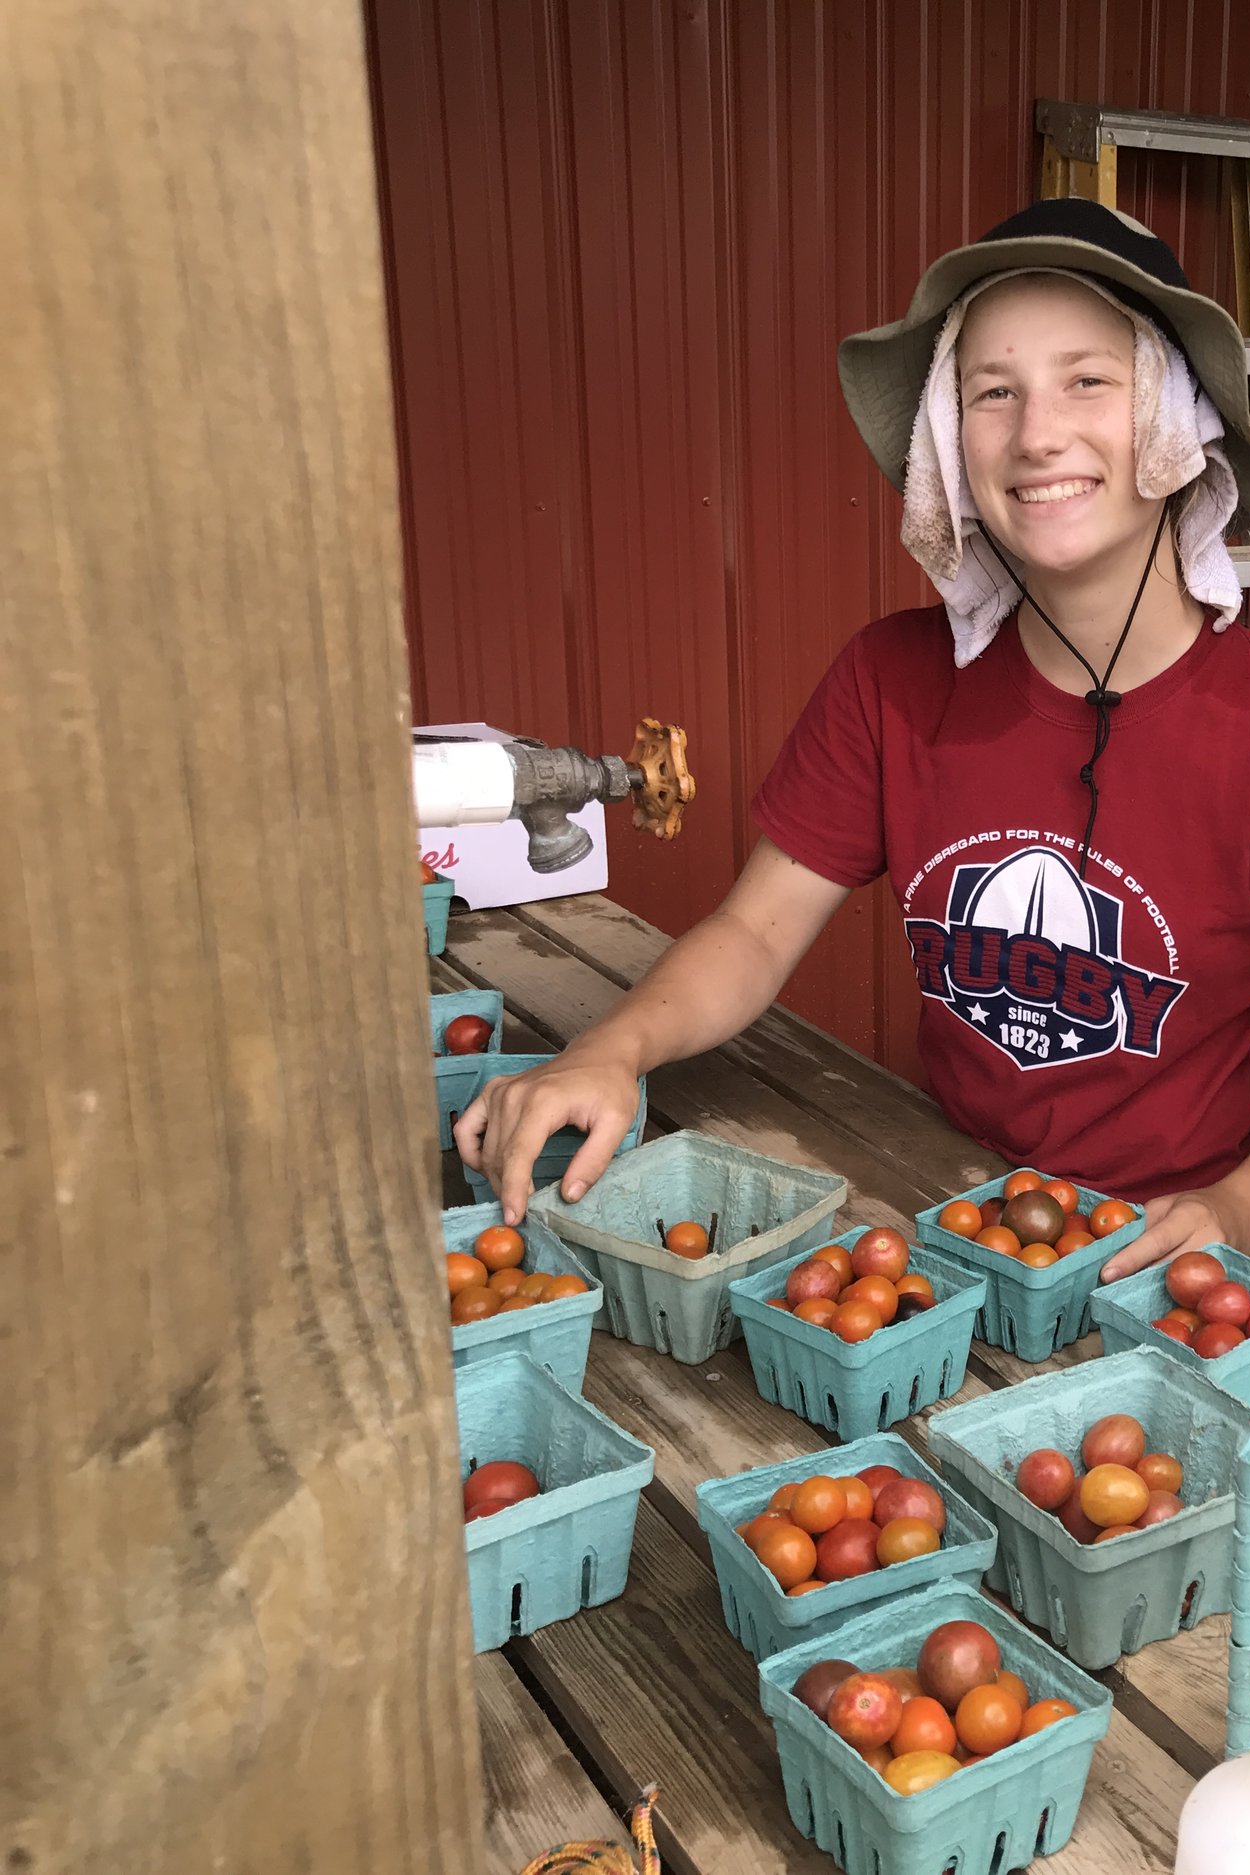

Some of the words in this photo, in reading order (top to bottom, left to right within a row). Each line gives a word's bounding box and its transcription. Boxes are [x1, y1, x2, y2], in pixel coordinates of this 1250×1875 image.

[1005, 829, 1039, 840] FOR
[1043, 831, 1076, 849] THE
[923, 831, 1001, 874] DISREGARD
[904, 870, 925, 901] FINE
[1123, 875, 1144, 895] OF
[903, 903, 911, 913] A
[1141, 895, 1180, 976] FOOTBALL
[908, 921, 1183, 1051] RUGBY
[1007, 1005, 1047, 1028] since
[999, 1022, 1050, 1060] 1823
